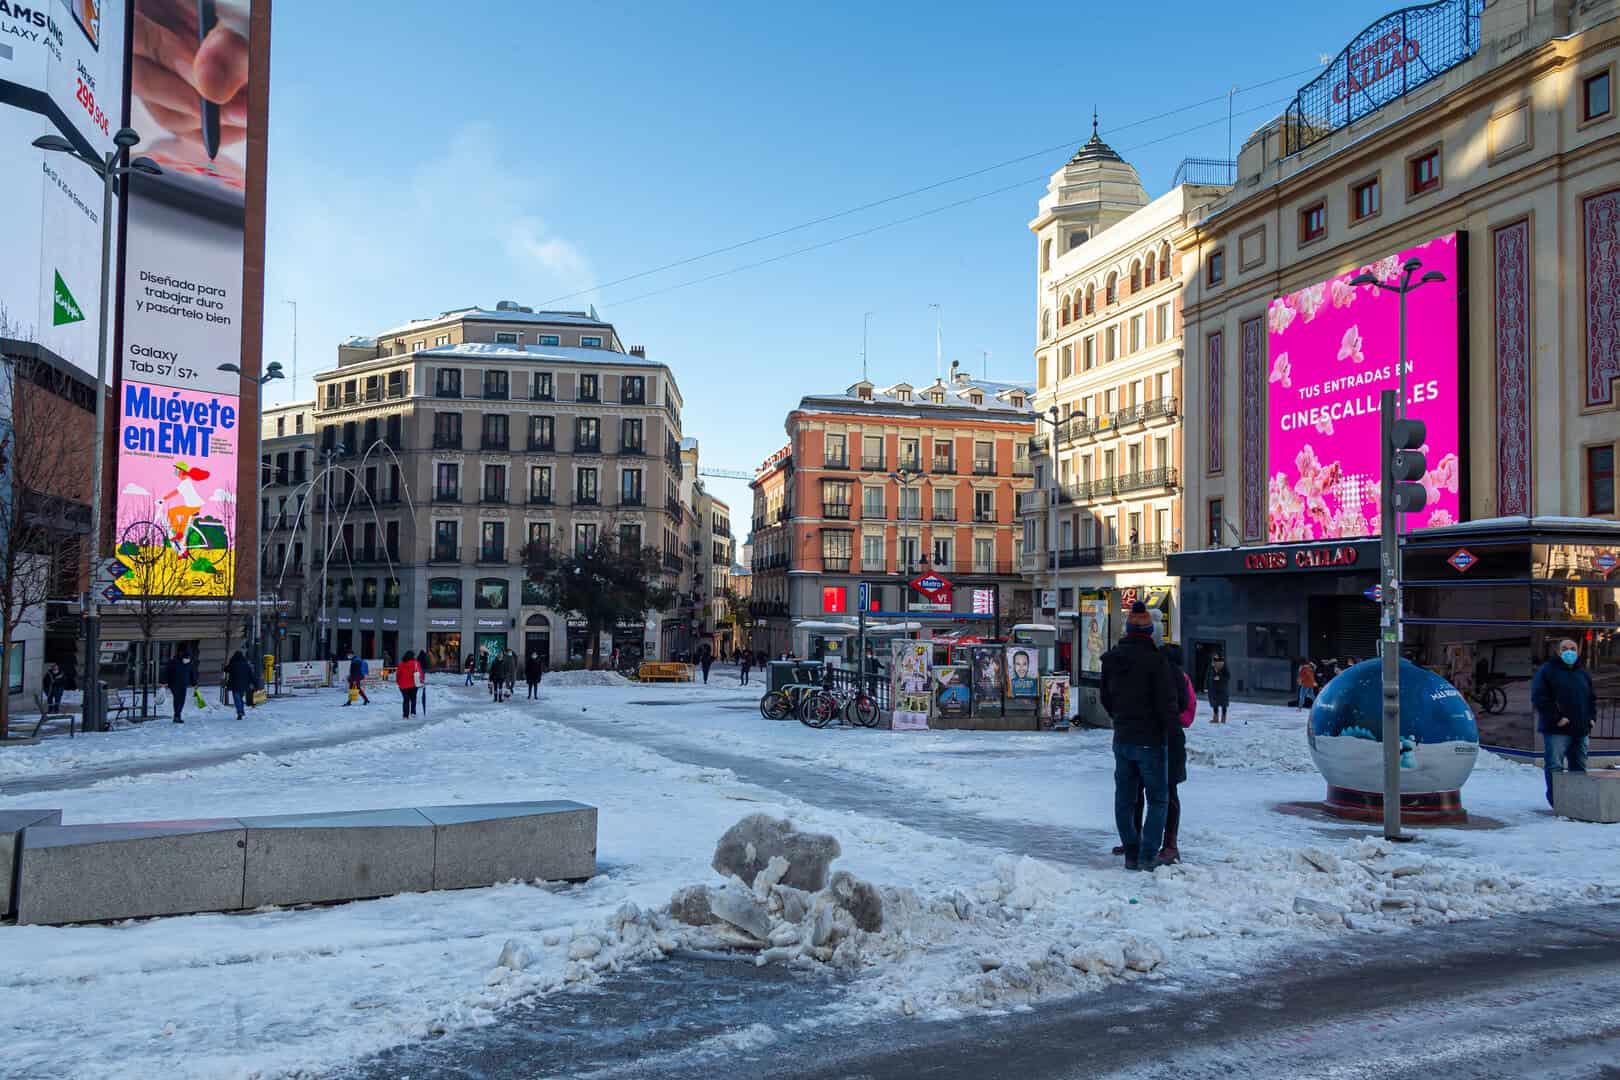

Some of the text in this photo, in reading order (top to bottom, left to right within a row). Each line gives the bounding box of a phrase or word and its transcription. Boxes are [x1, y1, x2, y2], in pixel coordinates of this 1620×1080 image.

[0, 0, 63, 46] AMSUNG
[1, 21, 39, 42] LAXY
[1349, 26, 1401, 71] CINES
[1333, 40, 1420, 104] CALLAO
[140, 271, 226, 297] Diseñada para
[145, 286, 224, 310] trabajar duro
[136, 300, 231, 324] y pasártelo bien
[130, 344, 178, 365] Galaxy
[130, 360, 198, 379] Tab S7 S7+
[1299, 360, 1414, 400] TUS ENTRADAS EN
[125, 384, 235, 429] Muévete
[1280, 381, 1439, 431] CINESCALL.ES
[124, 425, 155, 452] en
[158, 422, 214, 458] EMT
[1246, 547, 1358, 569] CINES CALLAO
[922, 580, 941, 588] Metro
